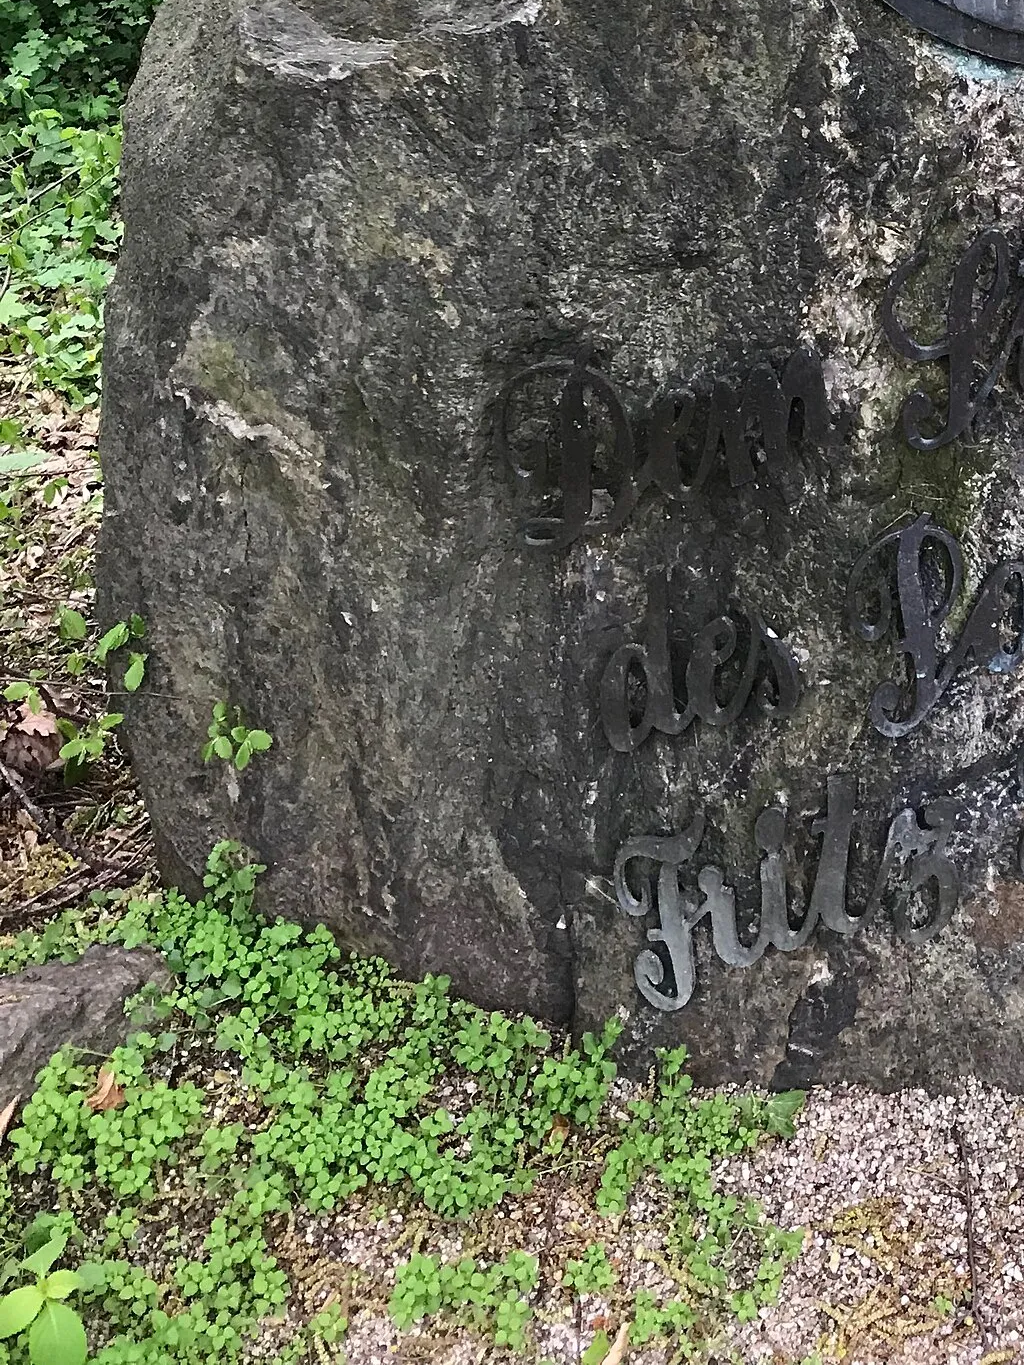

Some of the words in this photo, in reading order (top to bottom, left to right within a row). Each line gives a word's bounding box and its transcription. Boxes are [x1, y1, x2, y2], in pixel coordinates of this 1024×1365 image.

[494, 348, 834, 546] Dem
[600, 572, 799, 753] des
[614, 773, 960, 1012] Fritz
